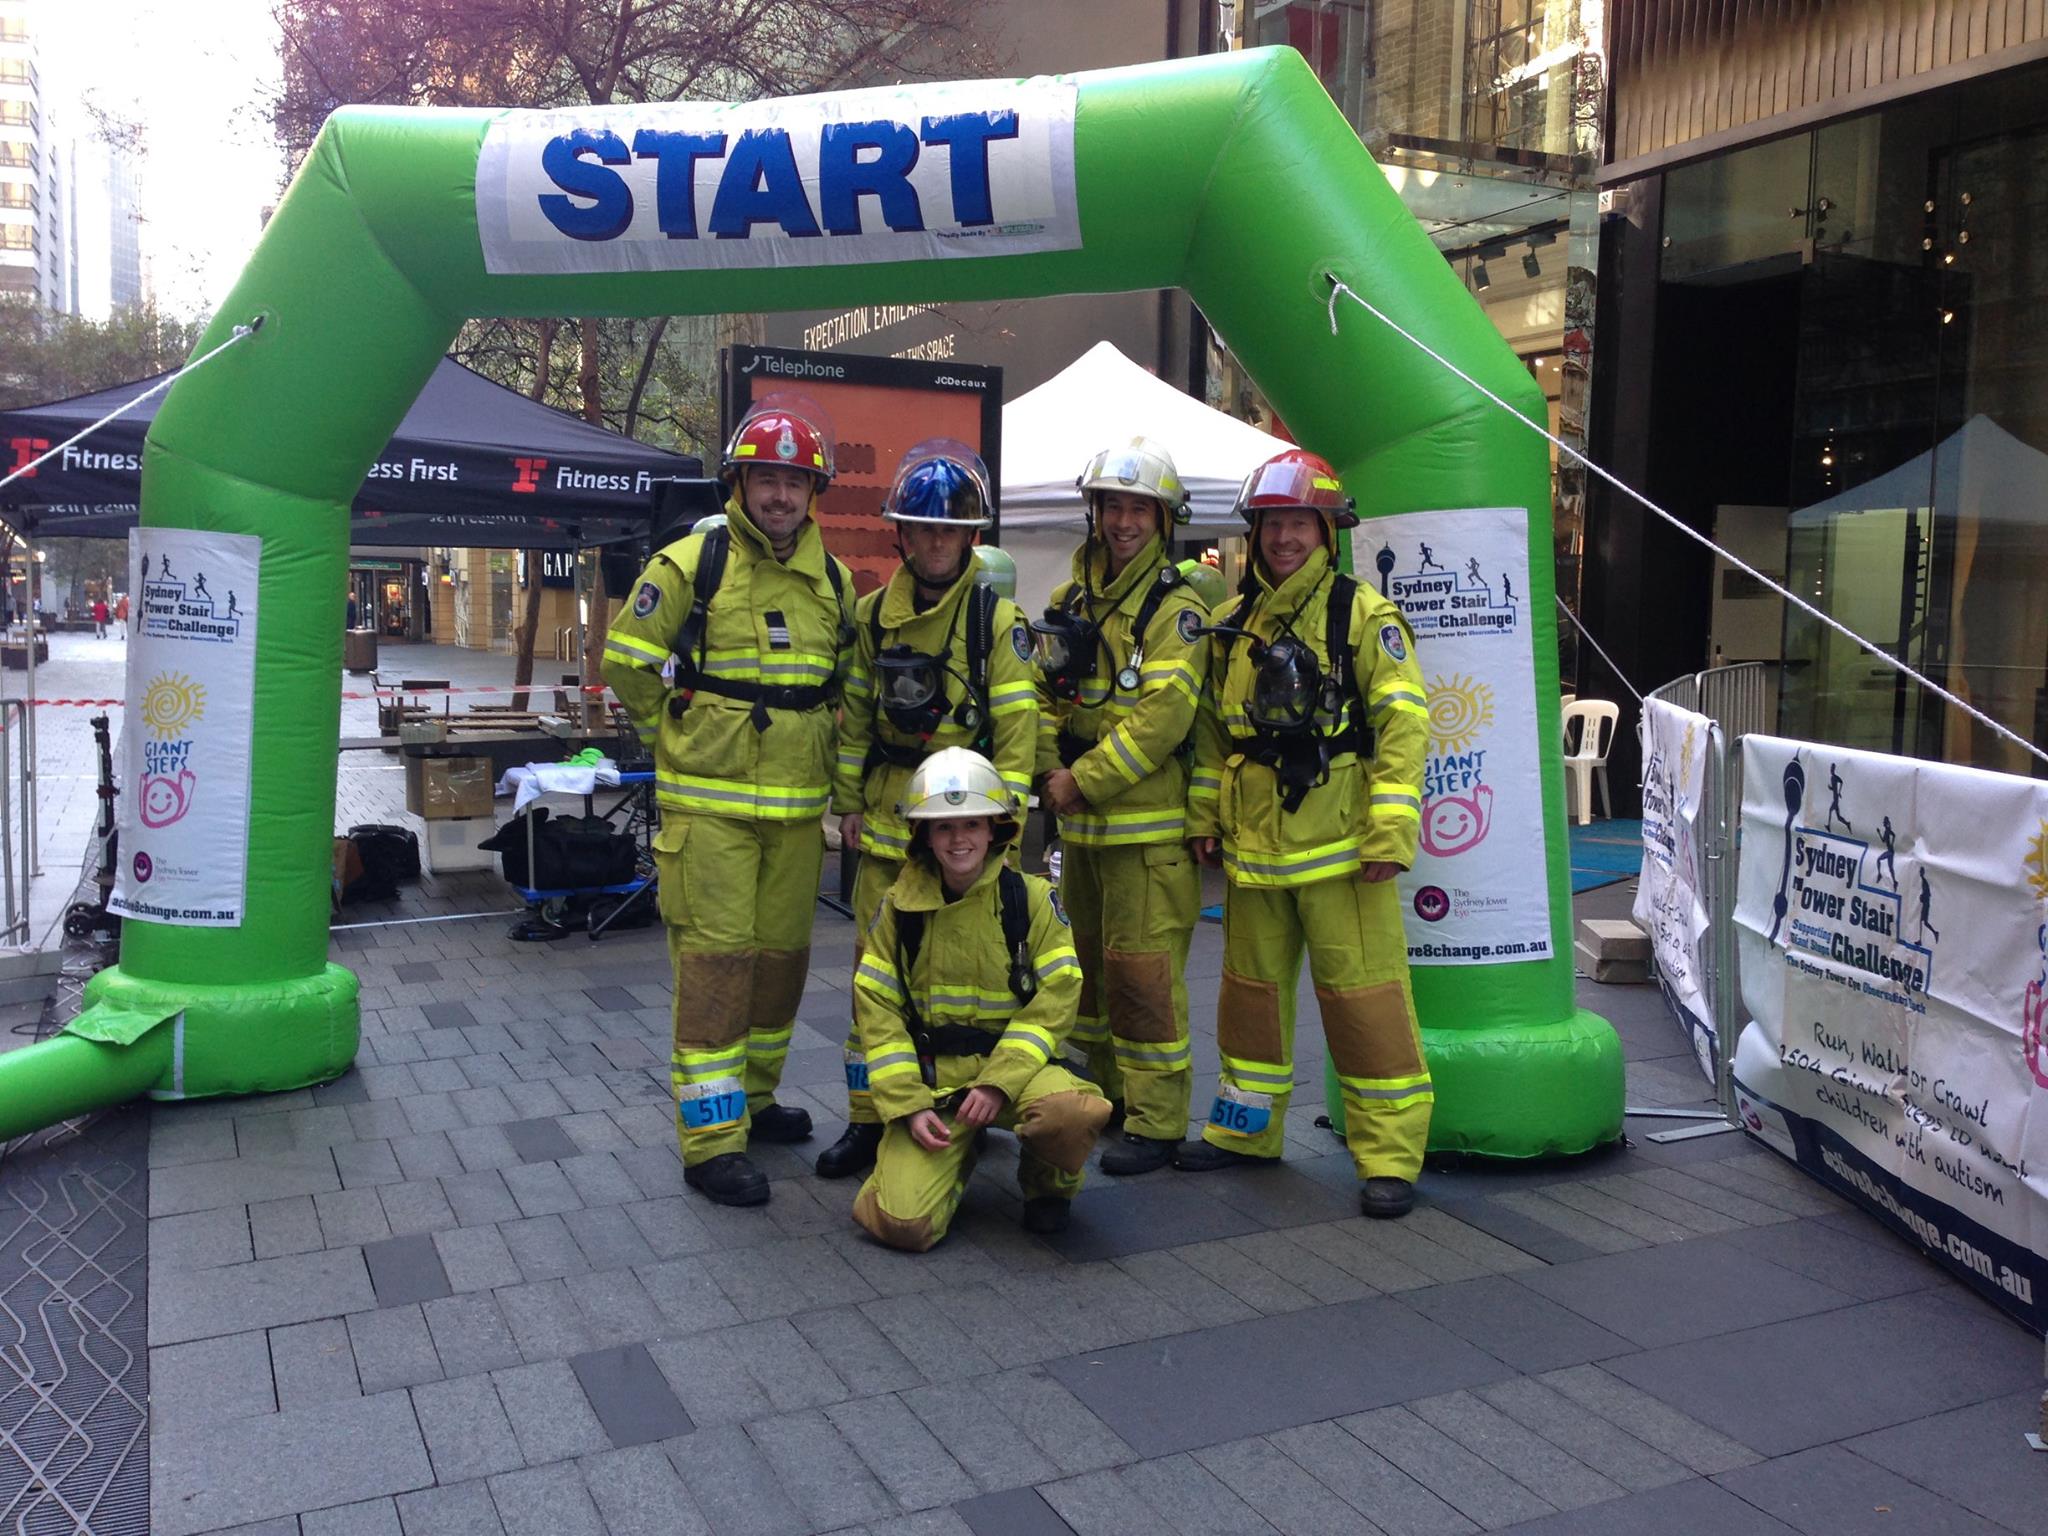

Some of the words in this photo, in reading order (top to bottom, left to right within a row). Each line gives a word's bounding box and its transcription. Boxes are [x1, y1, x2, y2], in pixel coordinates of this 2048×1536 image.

[538, 108, 1018, 241] START
[804, 306, 871, 351] EXPECTATION.
[926, 334, 955, 361] SPACE
[761, 355, 845, 378] Telephone
[935, 376, 987, 389] JCDecaux
[409, 458, 458, 482] First
[556, 466, 630, 491] Fitness
[543, 551, 573, 577] GAP
[145, 585, 182, 602] Sydney
[1392, 579, 1453, 598] Sydney
[144, 601, 174, 615] Tower
[178, 604, 210, 618] Stair
[1395, 598, 1445, 613] Tower
[1451, 595, 1488, 610] Stair
[168, 619, 235, 638] Challenge
[1438, 613, 1512, 628] Challenge
[144, 740, 194, 757] GIANT
[146, 756, 188, 776] STEPS
[1424, 769, 1482, 798] STEPS
[1795, 837, 1858, 889] Sydney
[1850, 895, 1894, 936] Stair
[1792, 918, 1833, 944] Supporting
[1407, 940, 1548, 959] ve8change.com.au
[1786, 954, 1799, 968] The
[1800, 959, 1824, 979] Sydney
[1848, 977, 1861, 991] Eye
[1831, 933, 1924, 995] Challenge
[1813, 1021, 1854, 1062] Run,
[1861, 1040, 1908, 1076] Walk
[1910, 1069, 1928, 1091] or
[1932, 1079, 1989, 1128] Crawl
[698, 1094, 734, 1125] 517
[1214, 1099, 1249, 1130] 516
[1816, 1085, 1889, 1140] children
[1934, 1154, 2004, 1206] autism
